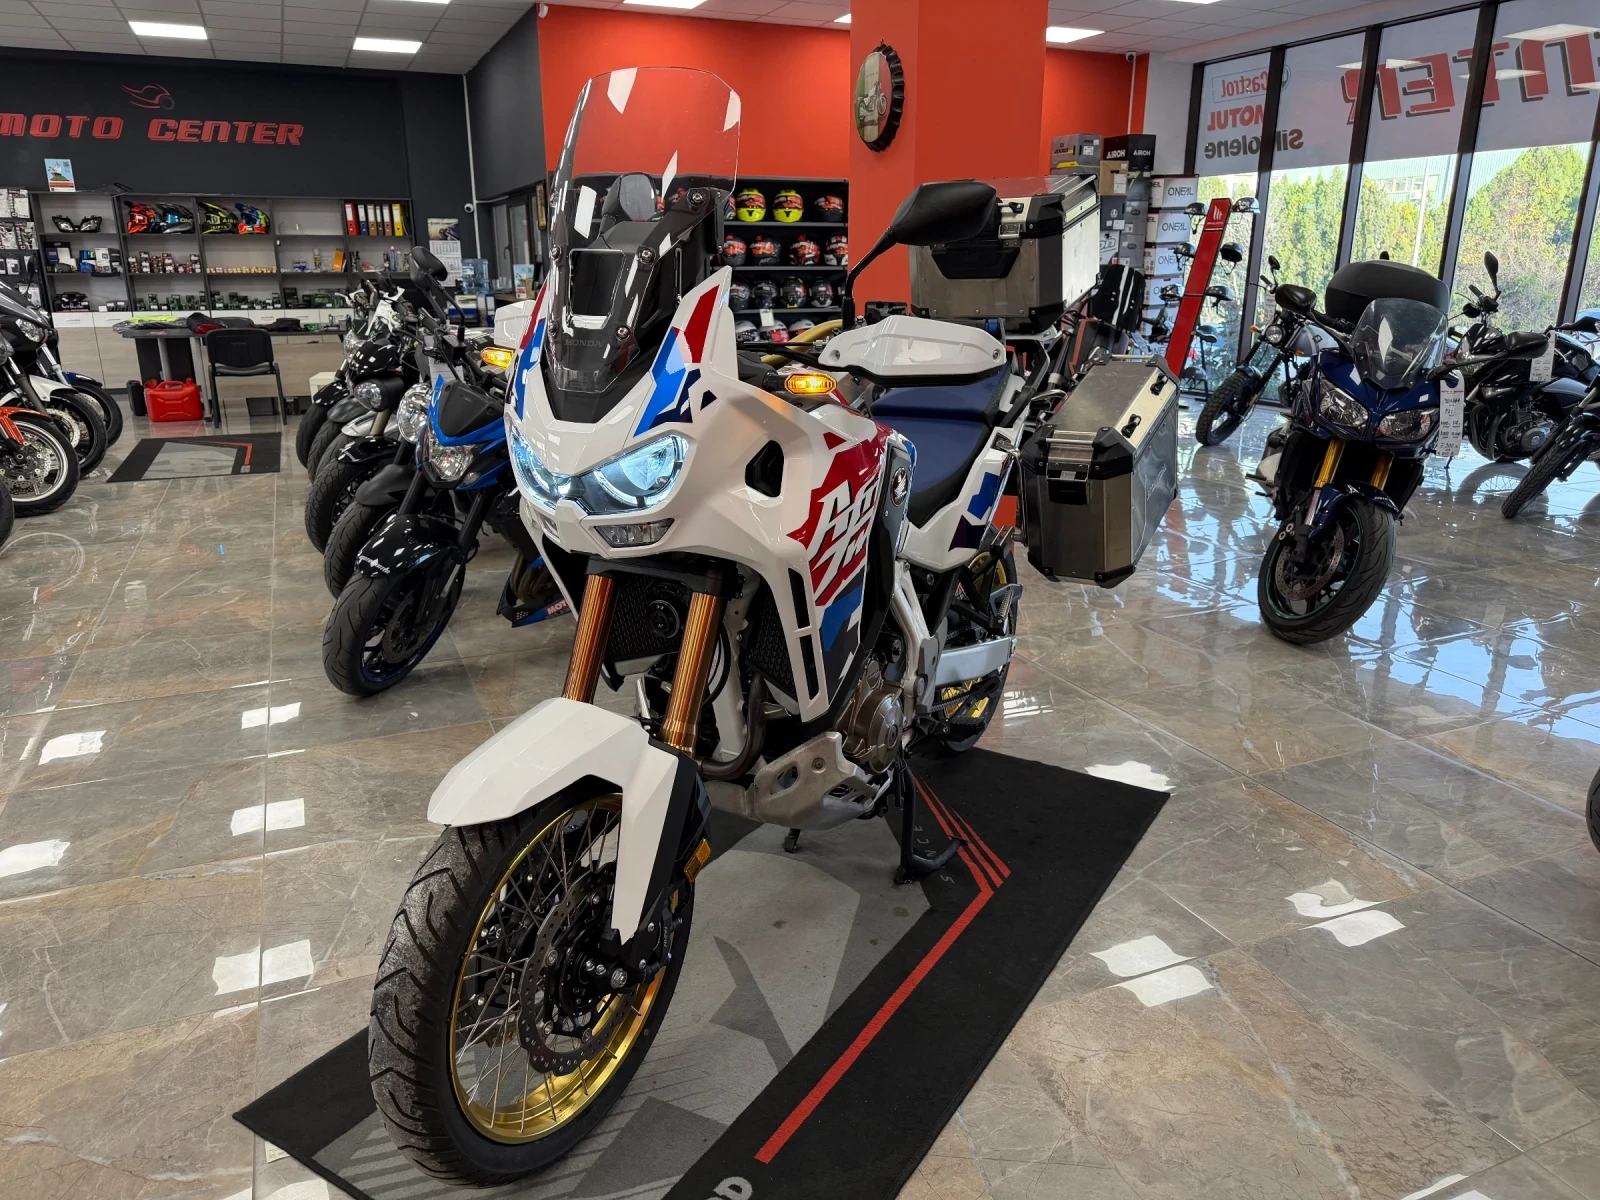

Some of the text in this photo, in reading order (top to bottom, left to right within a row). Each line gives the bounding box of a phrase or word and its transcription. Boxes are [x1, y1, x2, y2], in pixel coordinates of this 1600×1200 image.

[147, 118, 304, 146] CENTER
[1106, 149, 1126, 159] AIROH
[563, 338, 603, 348] HONDA
